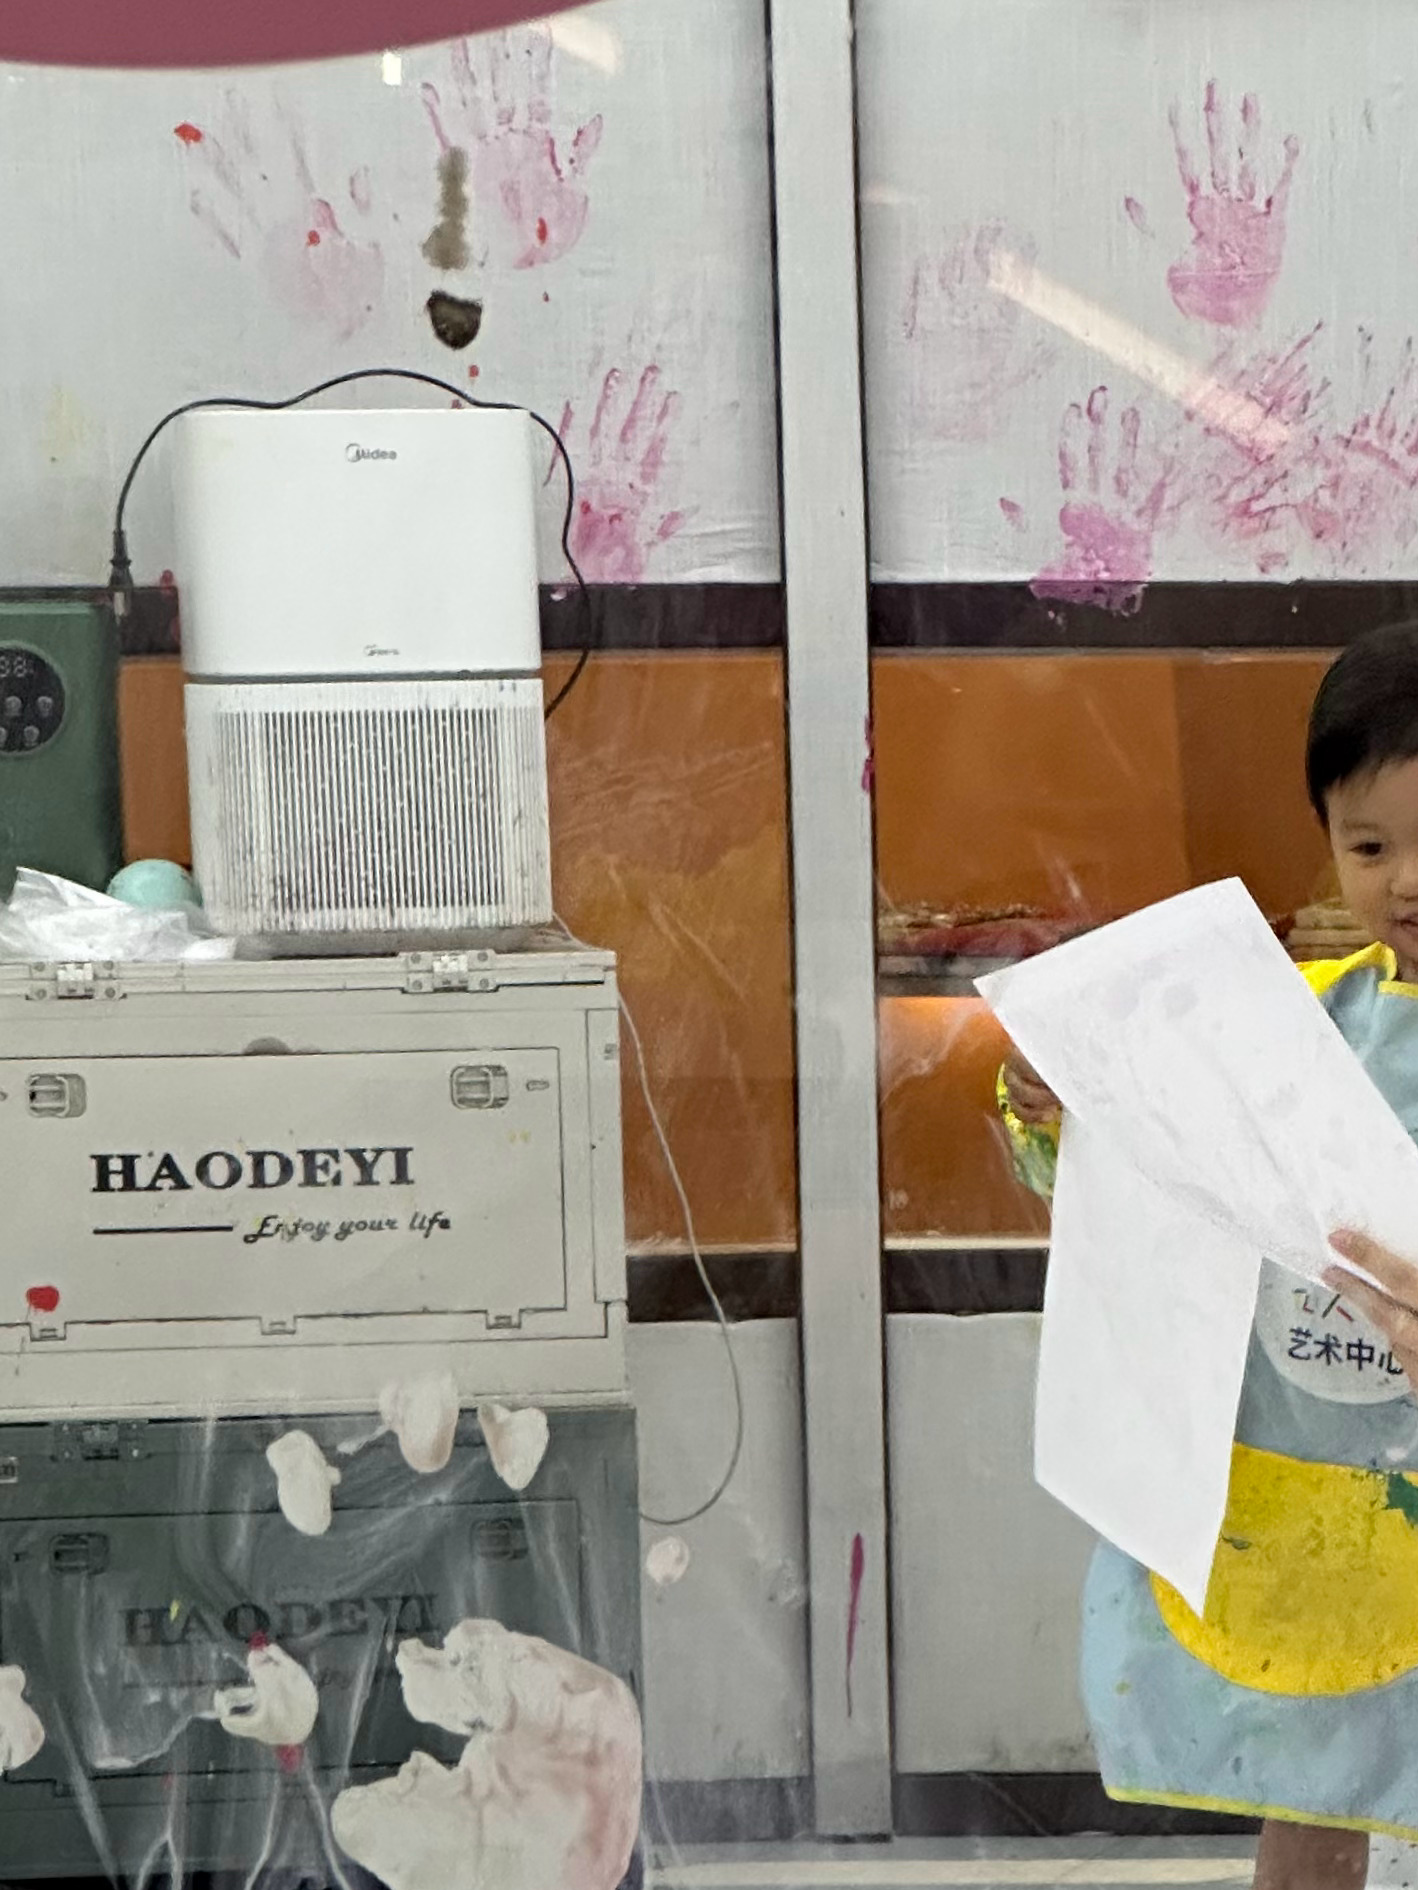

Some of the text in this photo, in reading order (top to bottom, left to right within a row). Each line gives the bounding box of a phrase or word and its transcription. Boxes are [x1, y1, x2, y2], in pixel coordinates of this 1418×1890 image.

[90, 1147, 415, 1193] HAODEYI
[243, 1211, 451, 1244] Enjoy your life
